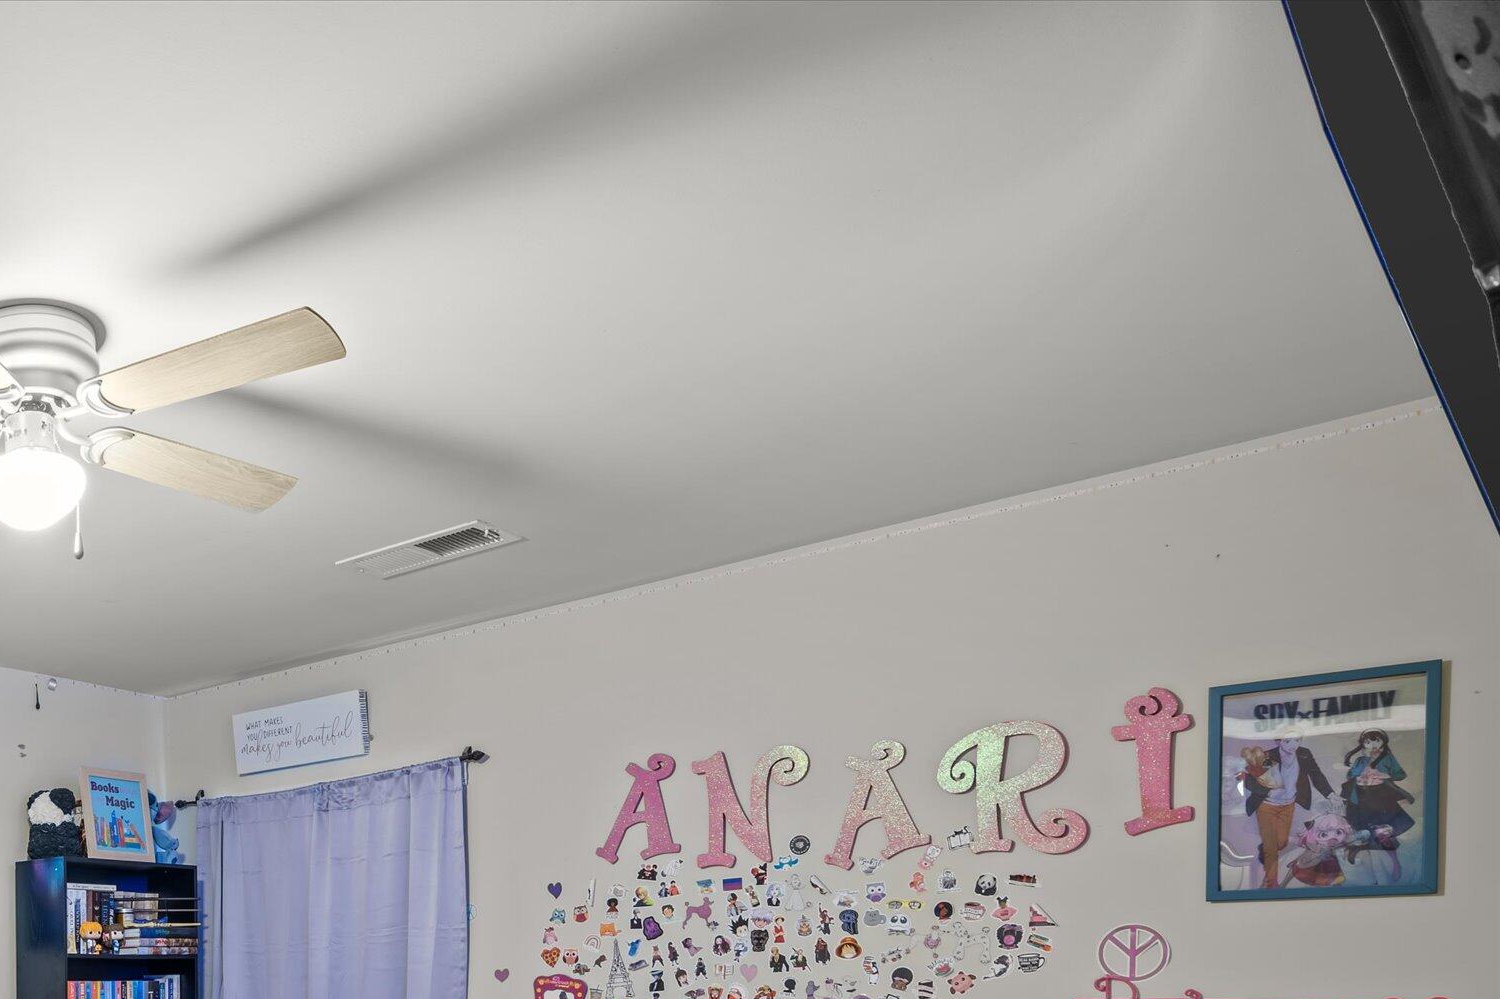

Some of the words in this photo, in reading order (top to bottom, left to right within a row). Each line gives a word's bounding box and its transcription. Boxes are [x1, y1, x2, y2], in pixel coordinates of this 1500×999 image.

[245, 720, 261, 731] WHAT
[264, 716, 284, 727] MAKES
[294, 711, 354, 749] beautiful
[263, 726, 292, 740] DIFFERENT
[90, 781, 120, 794] Books
[105, 796, 135, 810] Magic
